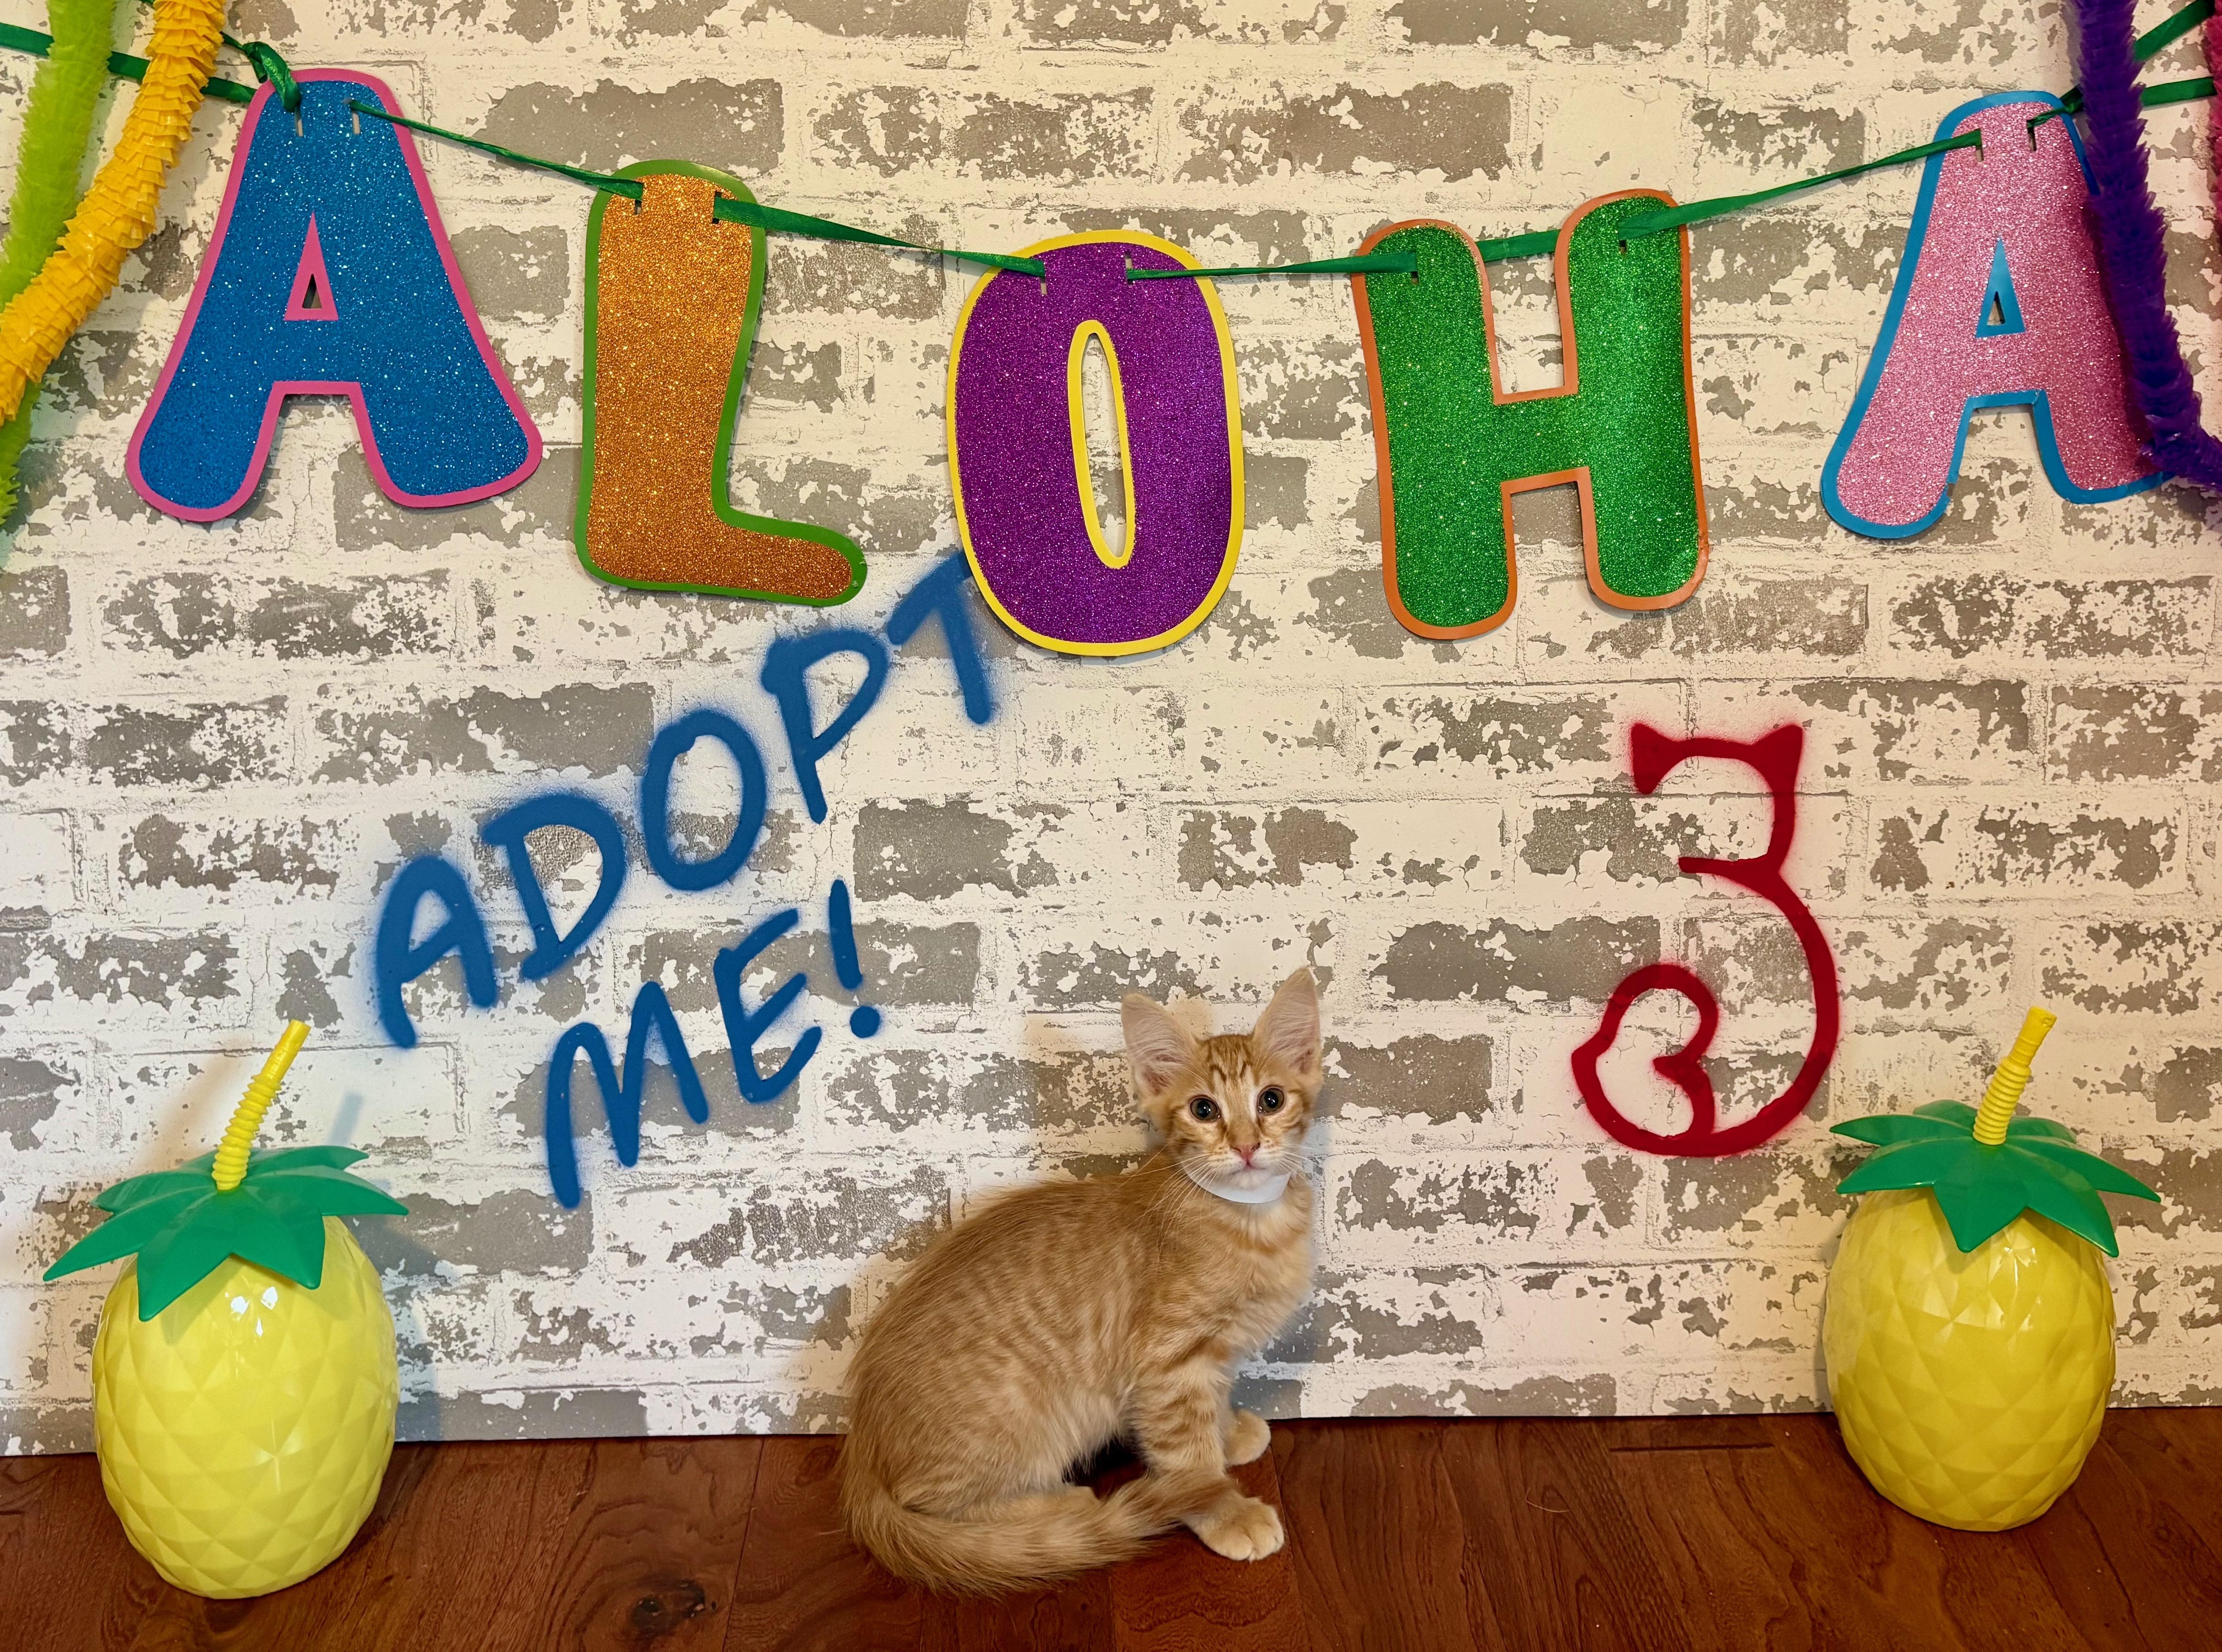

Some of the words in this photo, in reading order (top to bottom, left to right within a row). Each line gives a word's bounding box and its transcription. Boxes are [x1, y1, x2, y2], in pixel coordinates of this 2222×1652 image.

[127, 68, 2176, 657] ALOHA
[375, 552, 993, 1048] ADOPT
[545, 878, 881, 1210] ME!
